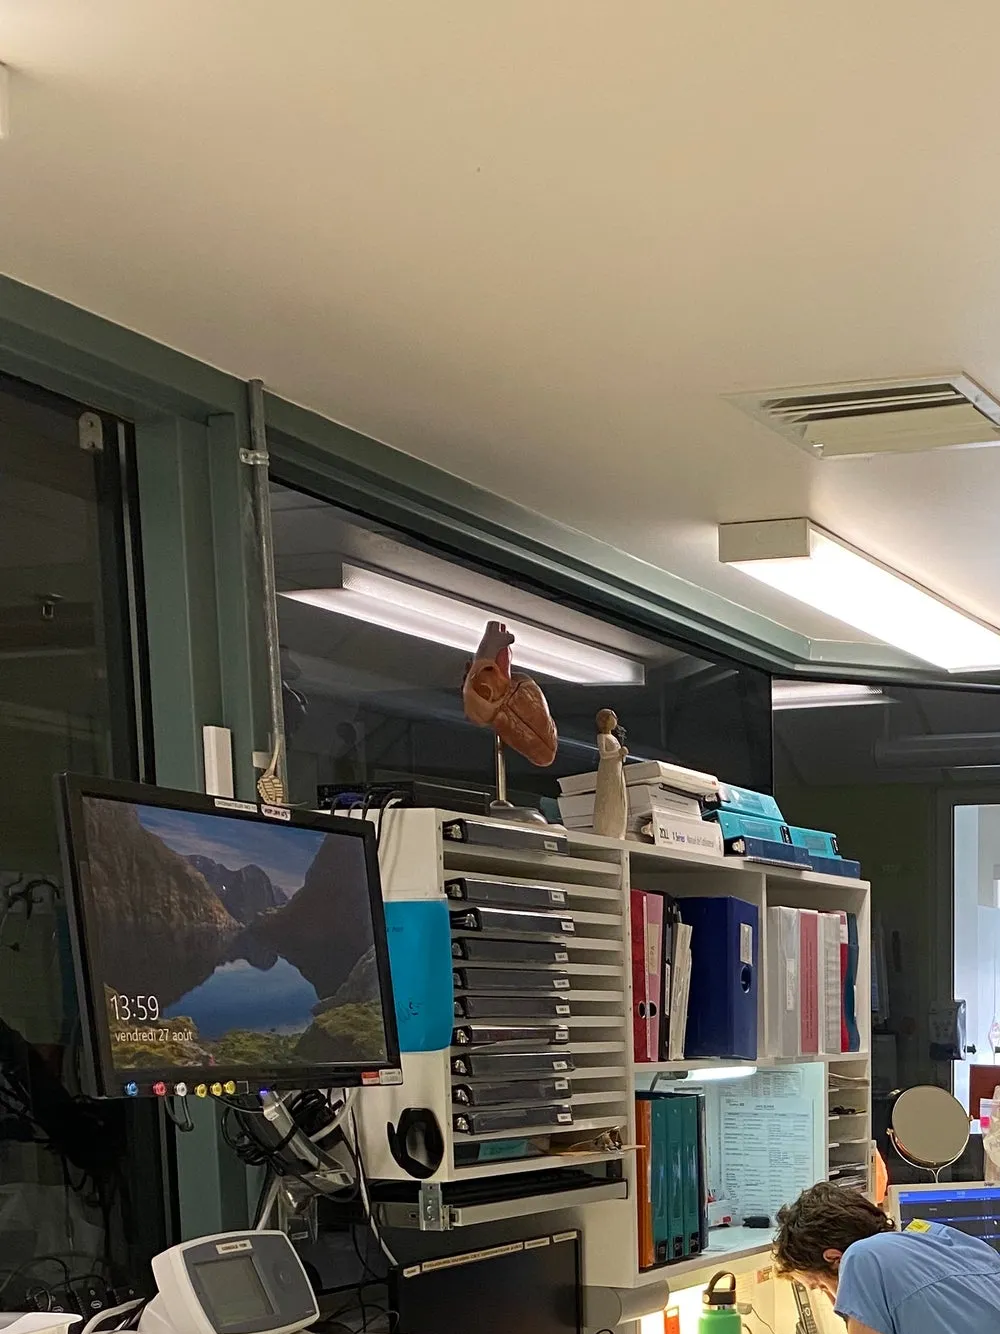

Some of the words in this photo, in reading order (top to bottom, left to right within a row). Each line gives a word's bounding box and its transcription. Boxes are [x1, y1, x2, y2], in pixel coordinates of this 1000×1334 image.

[110, 994, 159, 1020] 13:59
[115, 1028, 156, 1042] vendredi
[159, 1028, 169, 1041] 27
